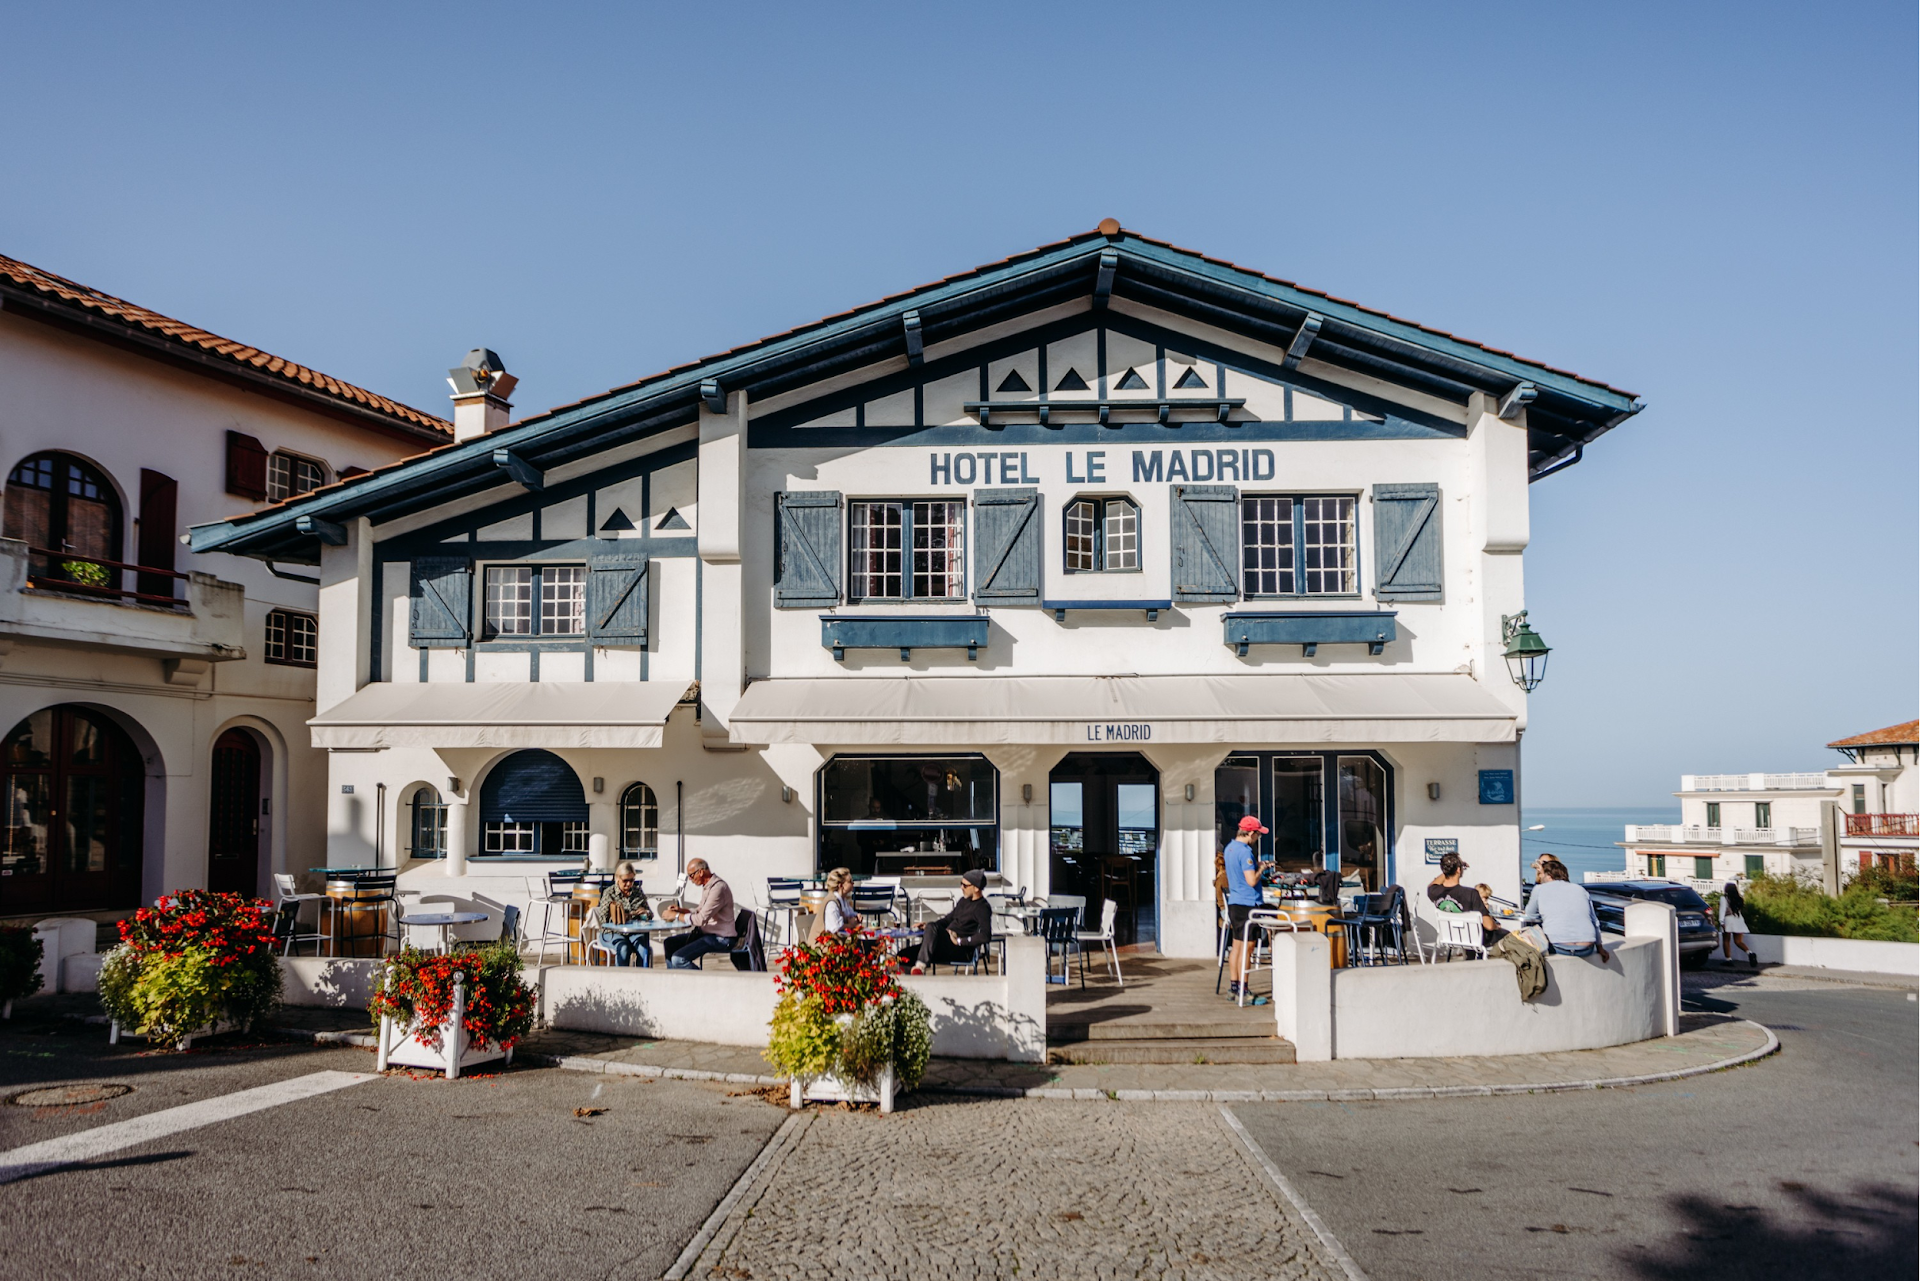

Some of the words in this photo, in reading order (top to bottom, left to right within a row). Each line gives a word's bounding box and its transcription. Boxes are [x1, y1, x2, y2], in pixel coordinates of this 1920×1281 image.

[931, 452, 1040, 485] HOTEL
[1066, 451, 1106, 484] LE
[1132, 448, 1276, 482] MADRID
[1087, 725, 1101, 741] LE
[1106, 724, 1151, 740] MADRID
